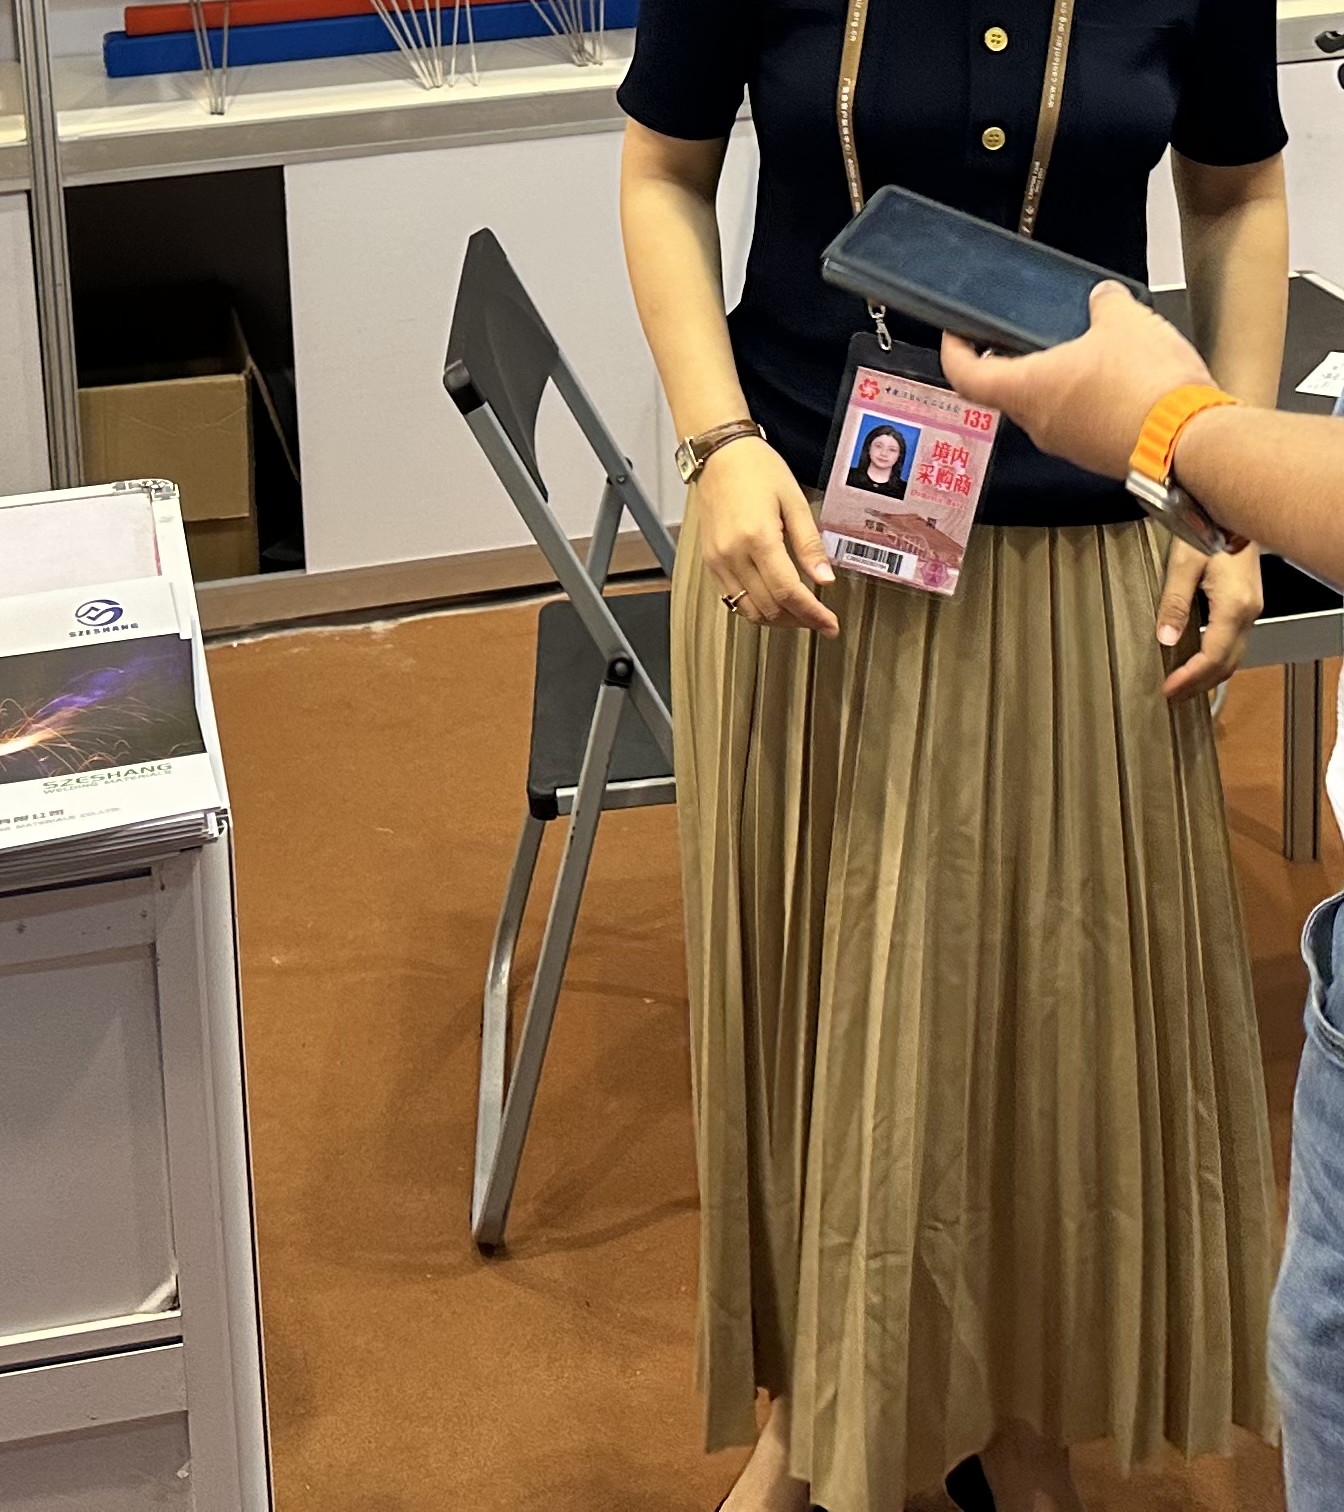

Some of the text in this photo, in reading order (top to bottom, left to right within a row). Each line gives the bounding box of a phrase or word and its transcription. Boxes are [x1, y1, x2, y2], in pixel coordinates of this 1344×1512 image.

[964, 408, 993, 431] 133
[932, 440, 970, 468] 境内
[916, 463, 972, 496] 采购商
[68, 622, 139, 638] SZESHANG
[43, 763, 172, 789] SZESHANG
[43, 769, 172, 794] WELDING MATERIALS
